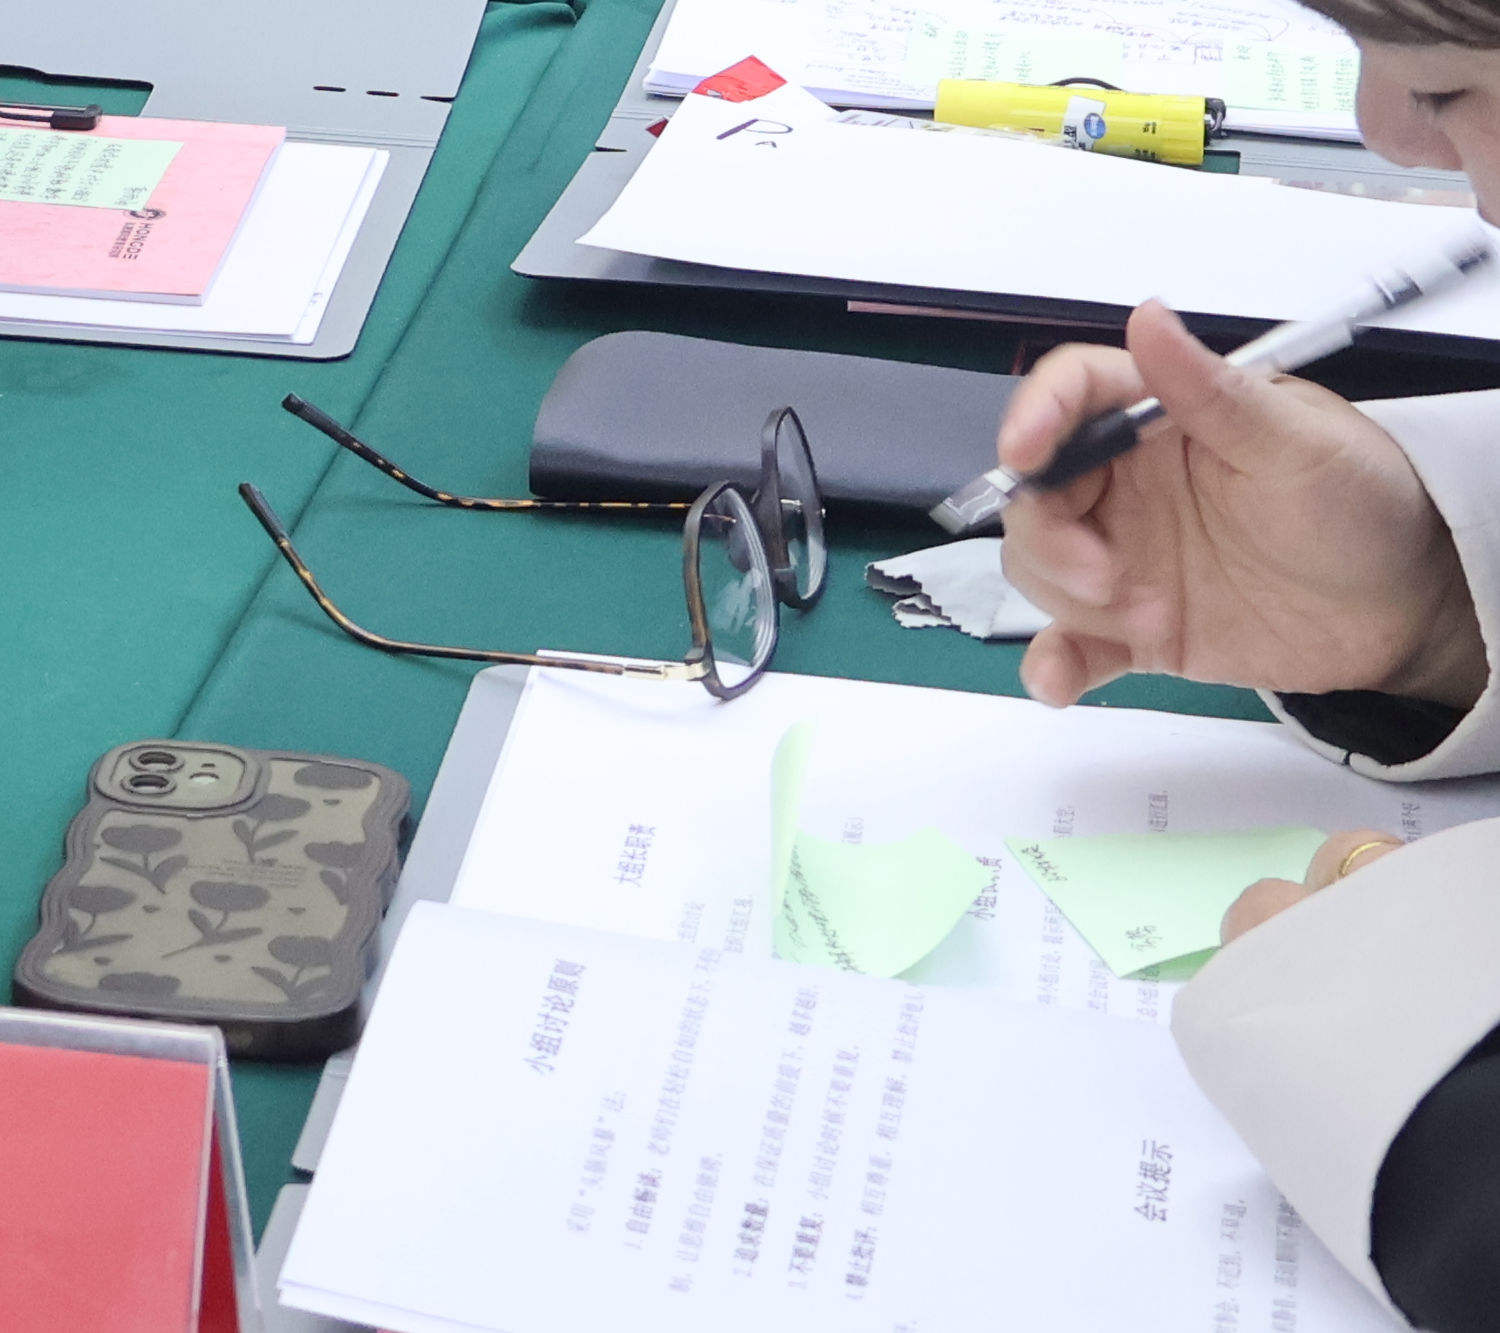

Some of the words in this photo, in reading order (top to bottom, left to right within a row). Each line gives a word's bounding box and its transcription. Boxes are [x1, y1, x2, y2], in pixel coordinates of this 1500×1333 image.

[122, 222, 154, 259] HONGDE
[613, 822, 657, 889] 大组长职责
[522, 956, 586, 1075] 小组讨论原则
[1132, 1139, 1176, 1221] 会议提示
